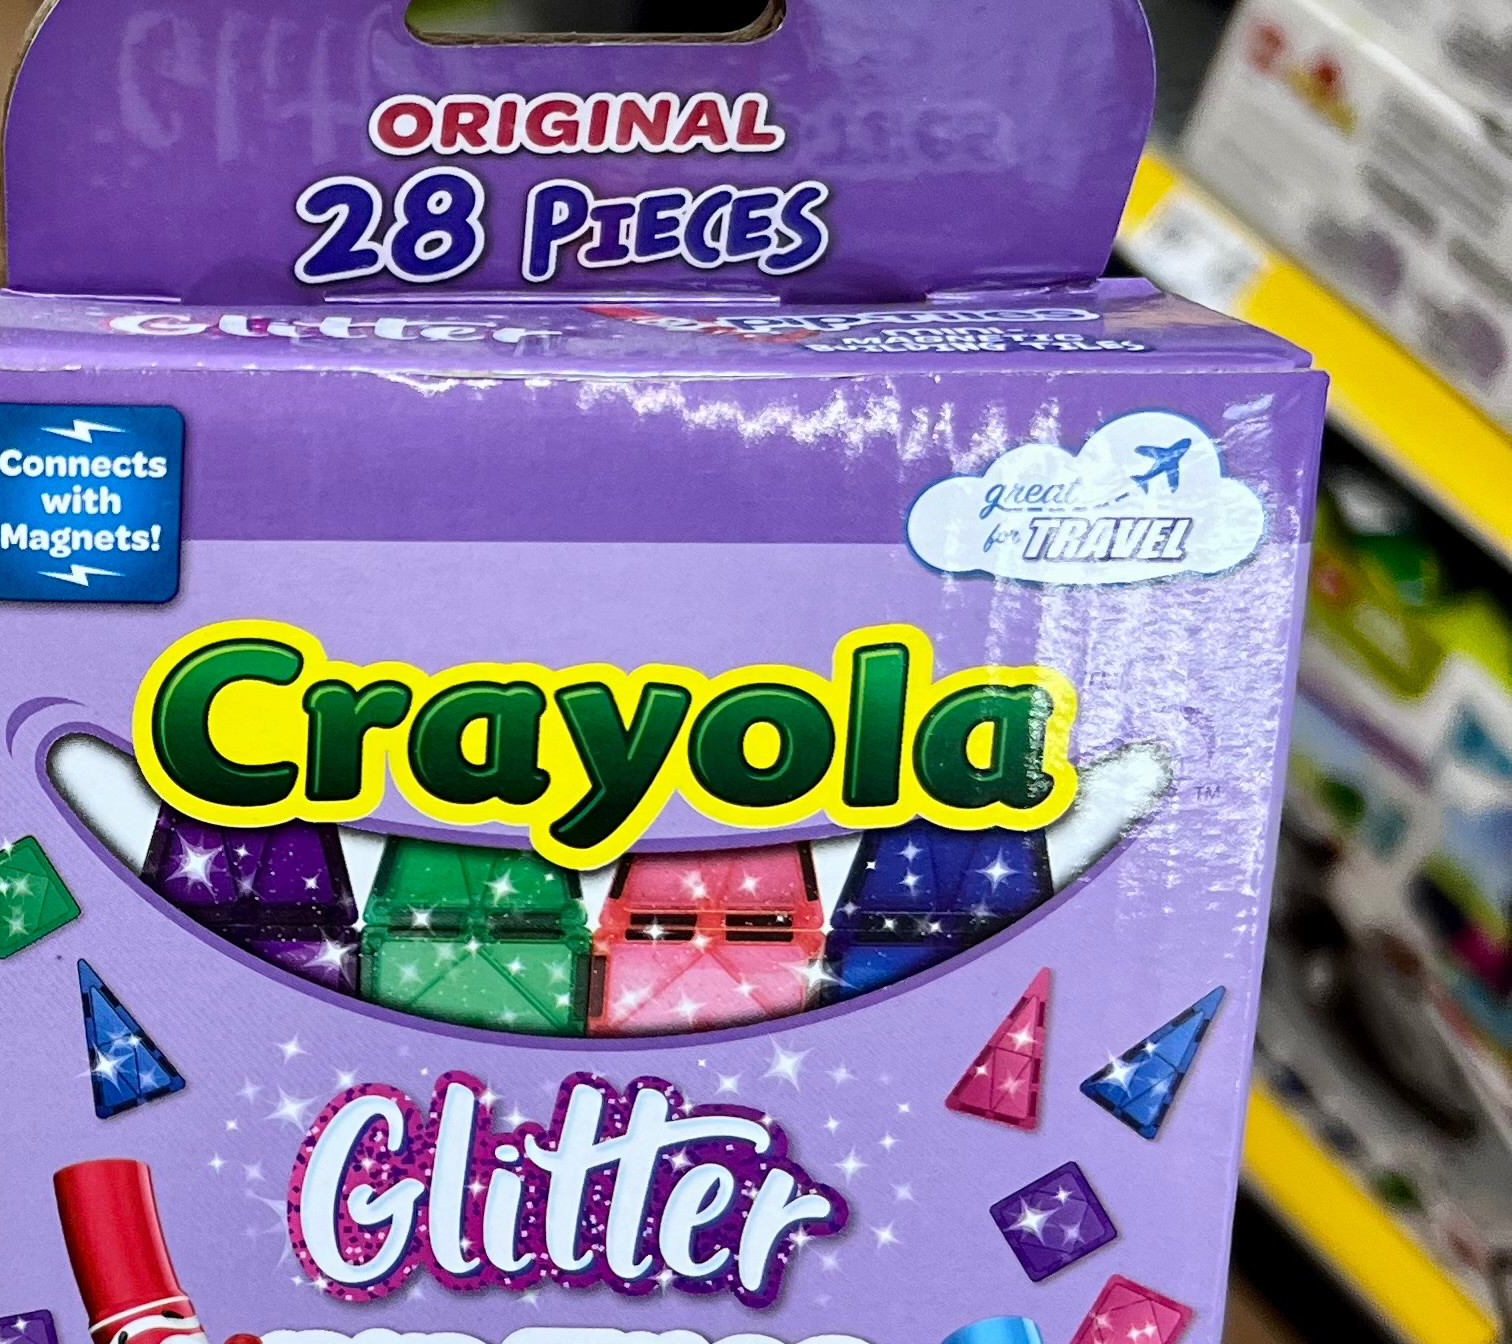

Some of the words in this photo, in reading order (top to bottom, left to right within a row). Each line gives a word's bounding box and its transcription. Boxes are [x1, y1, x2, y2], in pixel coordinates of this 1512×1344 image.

[368, 92, 785, 155] ORIGINAL
[294, 166, 486, 284] 28
[521, 179, 829, 282] PIECES
[41, 486, 122, 515] with
[979, 477, 1081, 520] great
[0, 523, 162, 558] Magnets!
[983, 523, 1021, 552] for
[1022, 518, 1193, 562] TRAVEL
[151, 637, 1054, 848] Crayola
[298, 1081, 831, 1294] Glitter
